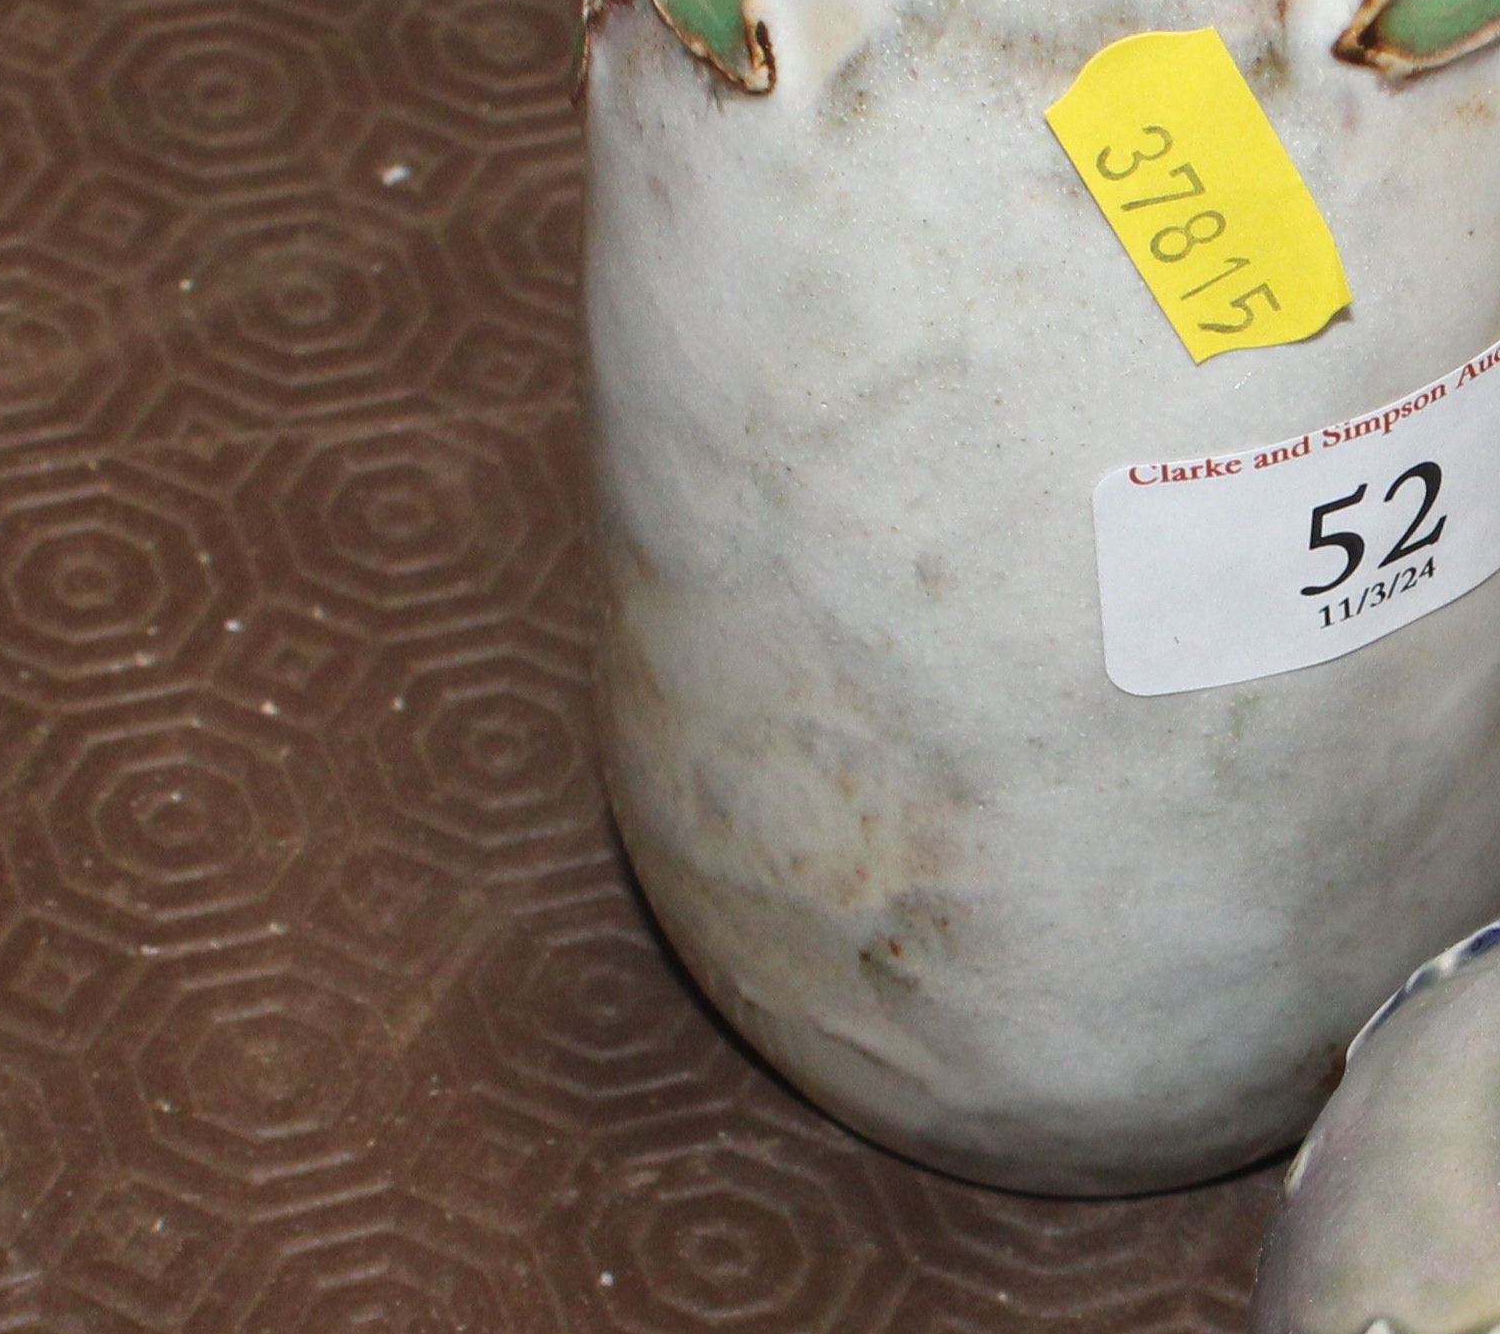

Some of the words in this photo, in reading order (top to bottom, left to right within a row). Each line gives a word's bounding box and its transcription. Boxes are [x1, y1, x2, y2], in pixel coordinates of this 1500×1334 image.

[1094, 123, 1282, 336] 37815
[1128, 458, 1243, 487] Clarke
[1253, 435, 1312, 471] and
[1321, 382, 1448, 450] Simpson
[1299, 460, 1448, 597] 52
[1317, 555, 1437, 629] 11/3/24
